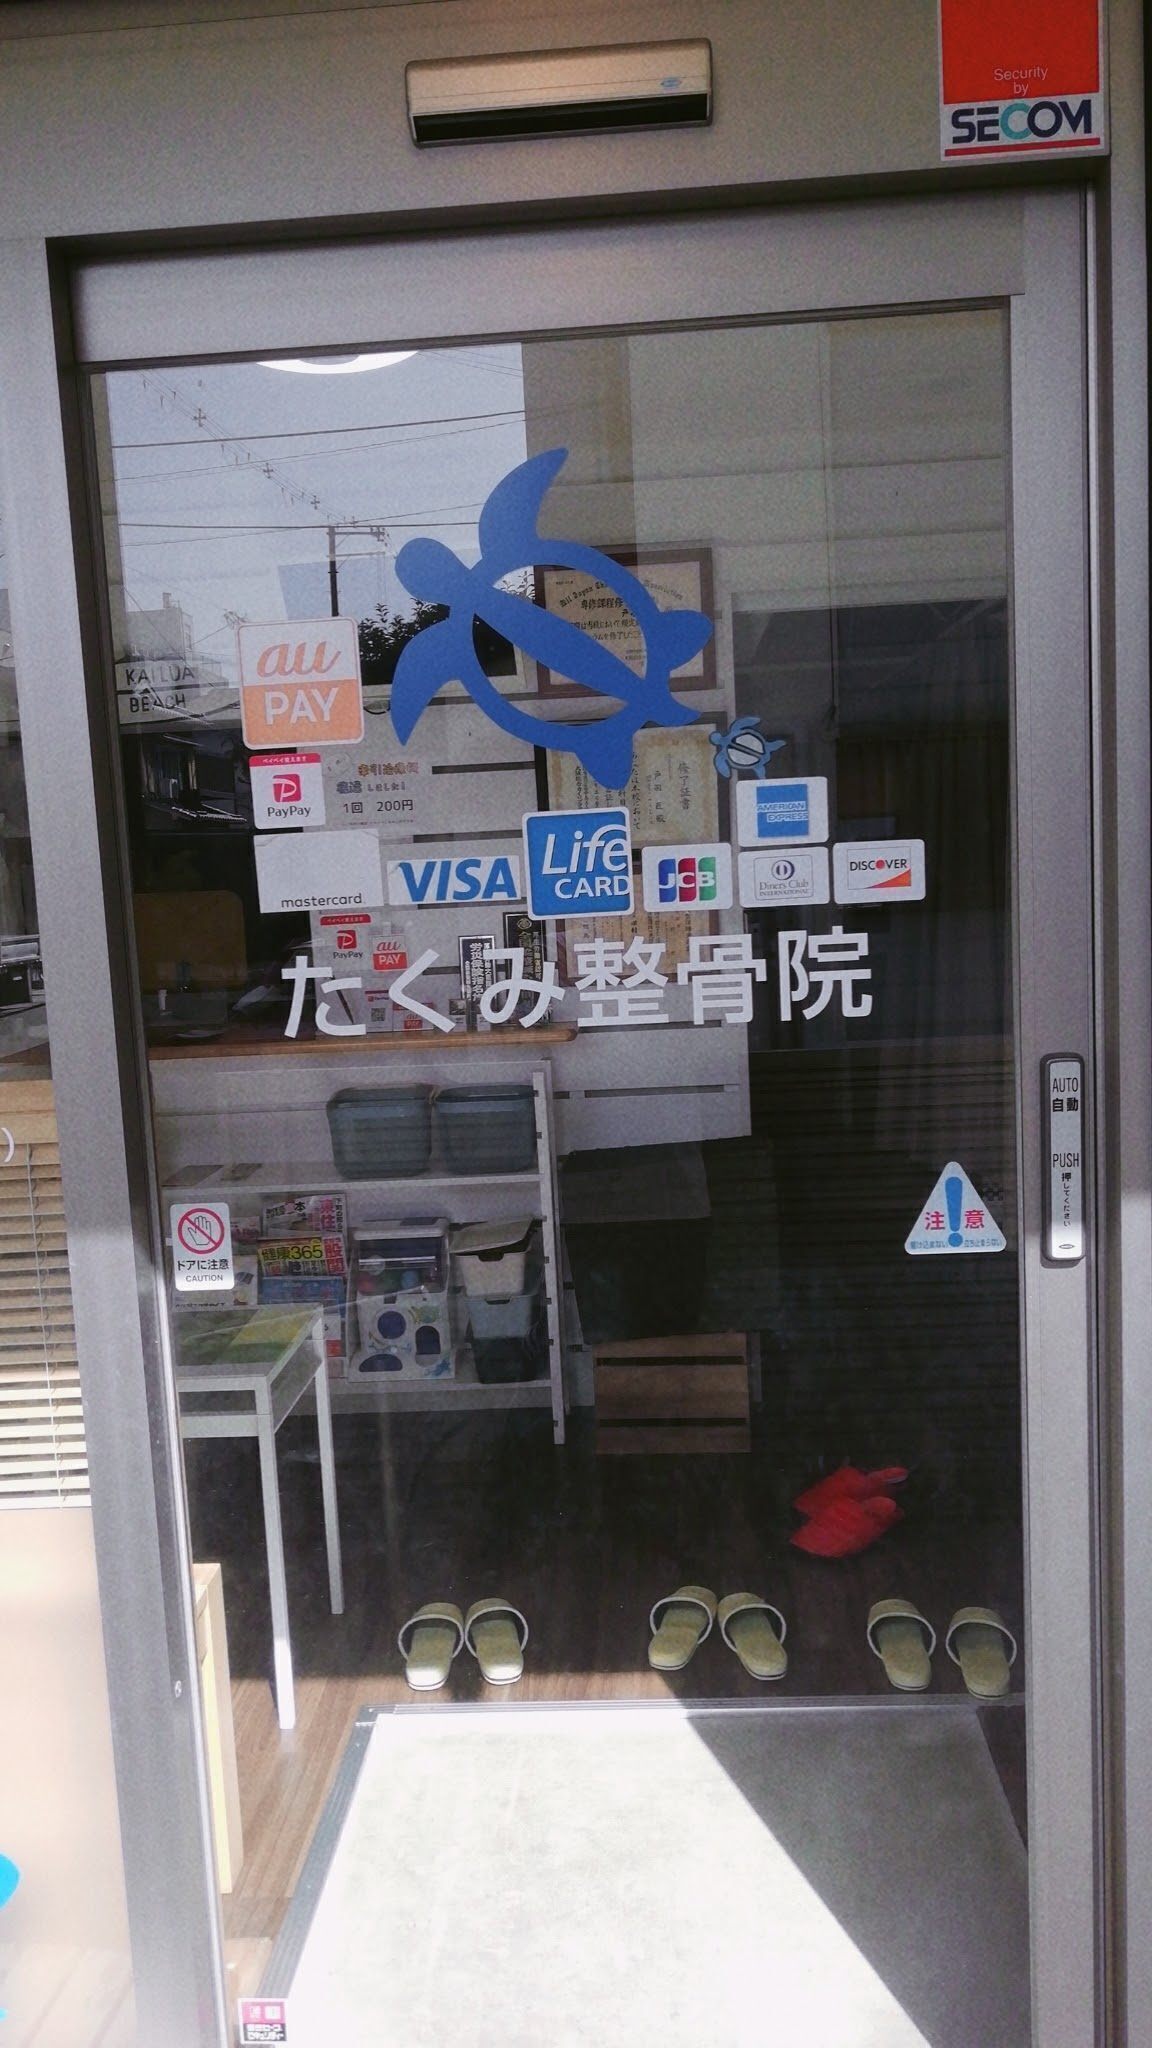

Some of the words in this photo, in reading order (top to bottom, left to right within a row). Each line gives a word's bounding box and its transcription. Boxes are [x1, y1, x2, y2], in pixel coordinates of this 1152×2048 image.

[994, 66, 1048, 81] Security
[1013, 82, 1029, 95] by
[951, 99, 1092, 144] SECOM
[256, 641, 341, 678] au
[125, 667, 195, 686] KAILUA
[130, 693, 186, 713] BEACH
[264, 687, 339, 725] PAY
[267, 805, 312, 819] PayPay
[343, 801, 363, 814] 1回
[376, 799, 414, 812] 200円
[757, 801, 805, 812] AMERICAN
[768, 812, 808, 822] EXPRESS
[542, 824, 628, 875] Life
[849, 858, 908, 872] DISCOVER
[399, 857, 518, 902] VISA
[554, 875, 630, 899] CARD
[759, 881, 787, 891] Diners
[788, 878, 809, 889] Club
[281, 892, 363, 909] mastercard
[376, 941, 401, 951] au
[332, 950, 364, 959] PayPay
[378, 954, 401, 965] PAY
[281, 926, 873, 1038] たくみ整骨院
[1052, 1077, 1079, 1093] AUTO
[1052, 1098, 1079, 1112] 自動
[1052, 1153, 1079, 1168] PUSH
[1062, 1172, 1072, 1227] 押してください
[925, 1211, 945, 1231] 注
[964, 1209, 985, 1229] 意
[177, 1258, 230, 1272] ドアに注意
[185, 1274, 224, 1283] CAUTION
